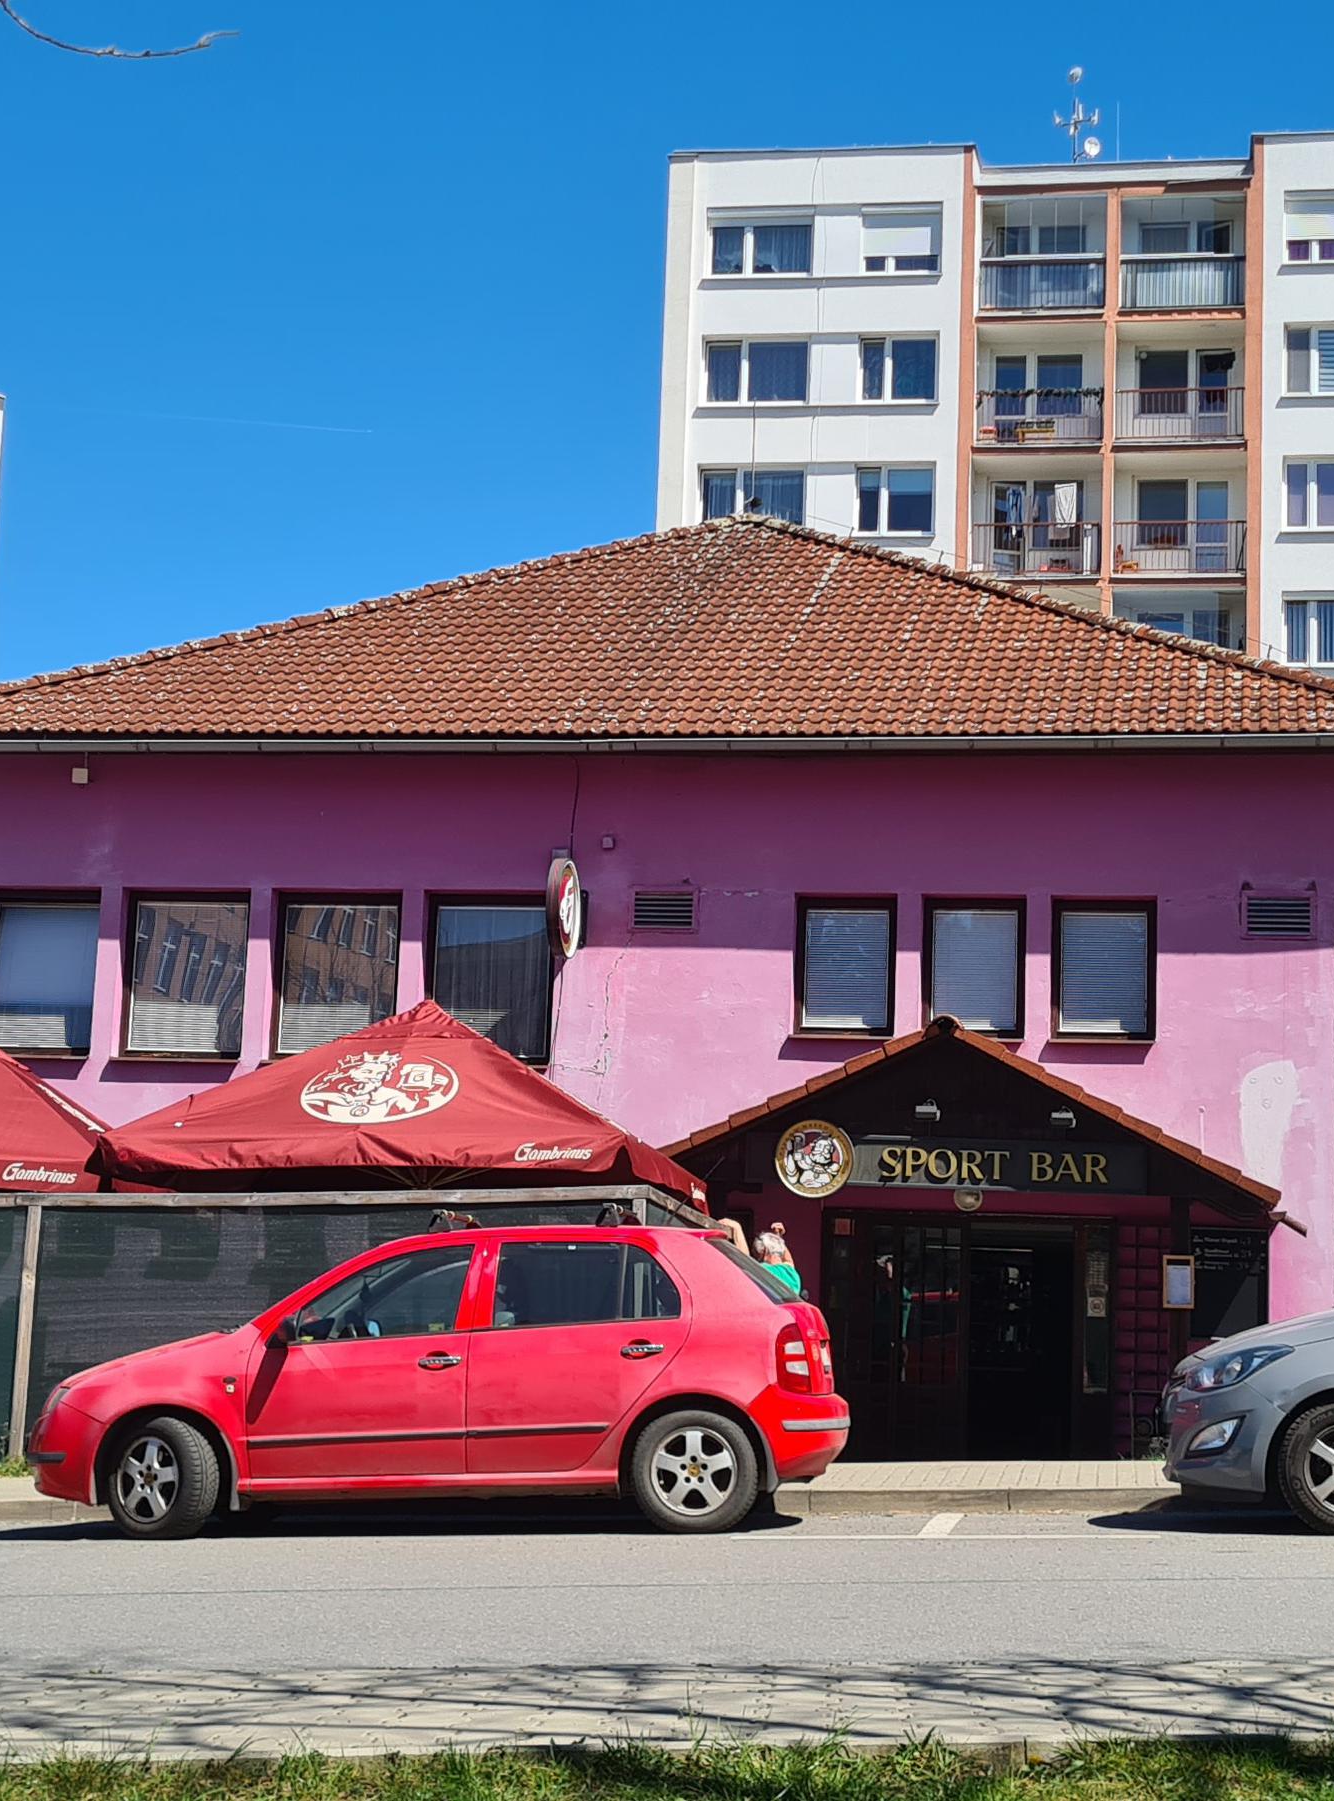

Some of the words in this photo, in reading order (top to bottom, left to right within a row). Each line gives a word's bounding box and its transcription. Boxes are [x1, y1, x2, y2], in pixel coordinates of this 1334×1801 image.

[514, 1142, 593, 1162] Gambrinus
[1, 1162, 78, 1184] Gambrinus
[880, 1146, 1010, 1181] SPORT
[1028, 1151, 1109, 1184] BAR
